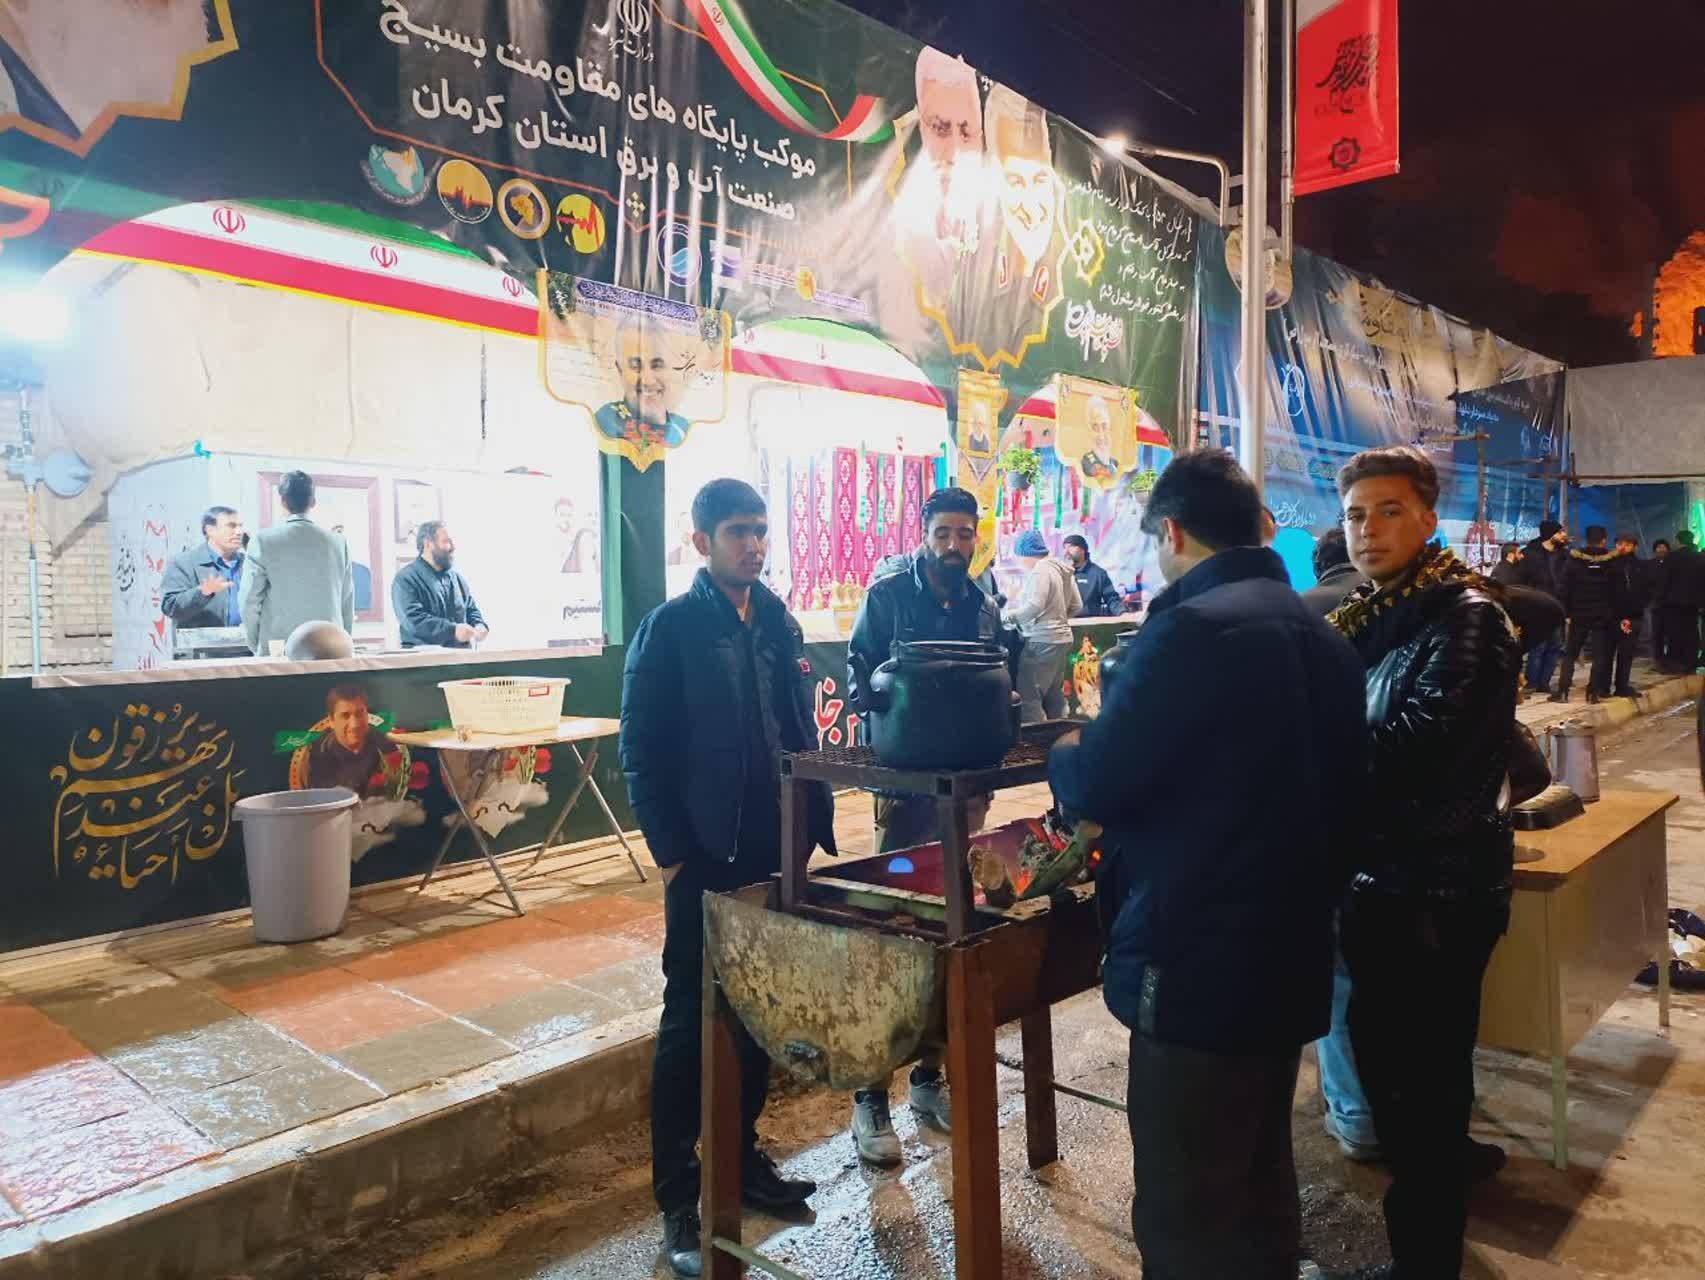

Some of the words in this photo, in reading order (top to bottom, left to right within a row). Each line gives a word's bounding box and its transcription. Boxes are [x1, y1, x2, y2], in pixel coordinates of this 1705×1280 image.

[379, 0, 488, 69] بسیج
[496, 43, 622, 101] مقاومت
[412, 78, 506, 134] کرمان
[628, 84, 676, 125] های
[515, 110, 608, 158] استان
[682, 104, 748, 164] پایگاه
[617, 136, 659, 181] برق
[666, 161, 680, 193] و
[754, 138, 816, 180] موکب
[688, 164, 723, 201] آب
[728, 181, 796, 220] صنعت
